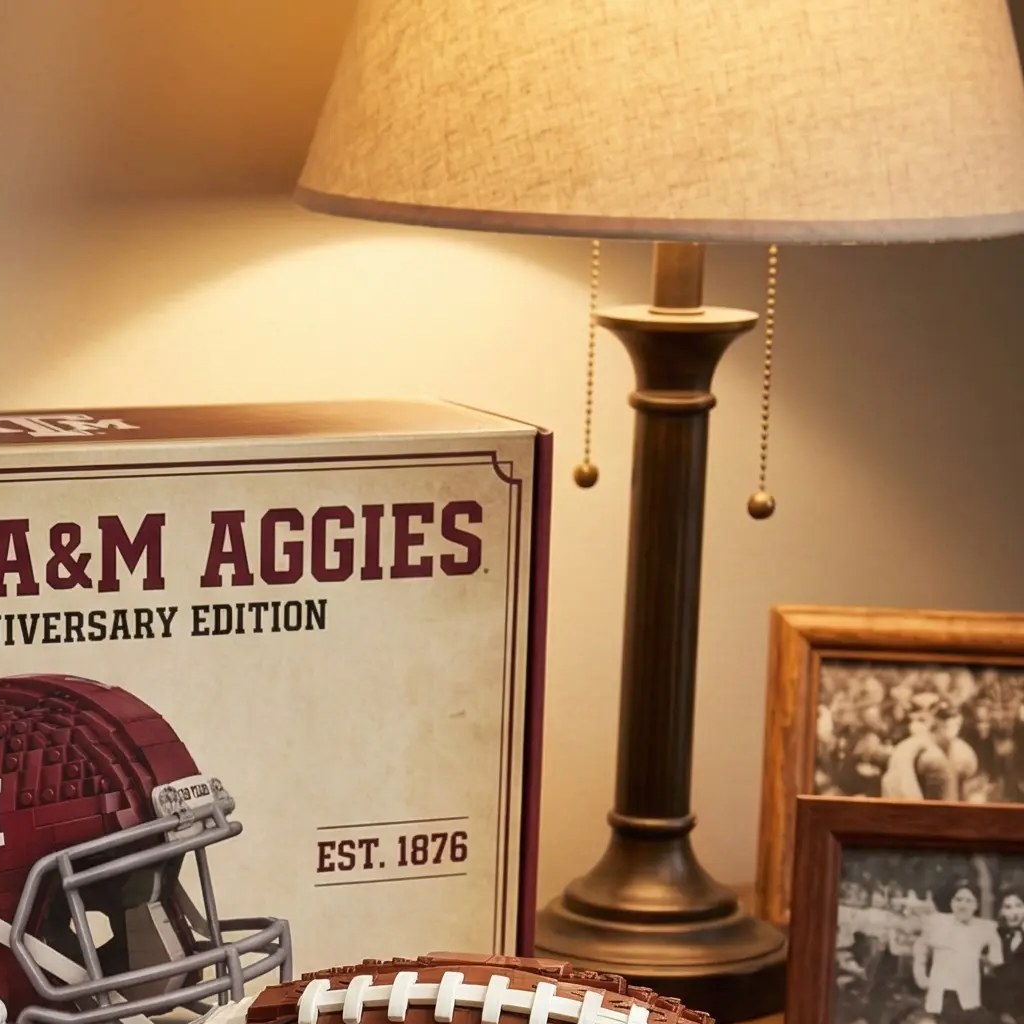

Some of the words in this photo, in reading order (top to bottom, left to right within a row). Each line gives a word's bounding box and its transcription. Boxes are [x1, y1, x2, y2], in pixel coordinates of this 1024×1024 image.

[199, 500, 483, 588] AGGIES
[191, 598, 328, 636] EDITION
[316, 837, 386, 873] EST.
[397, 830, 468, 867] 1876
